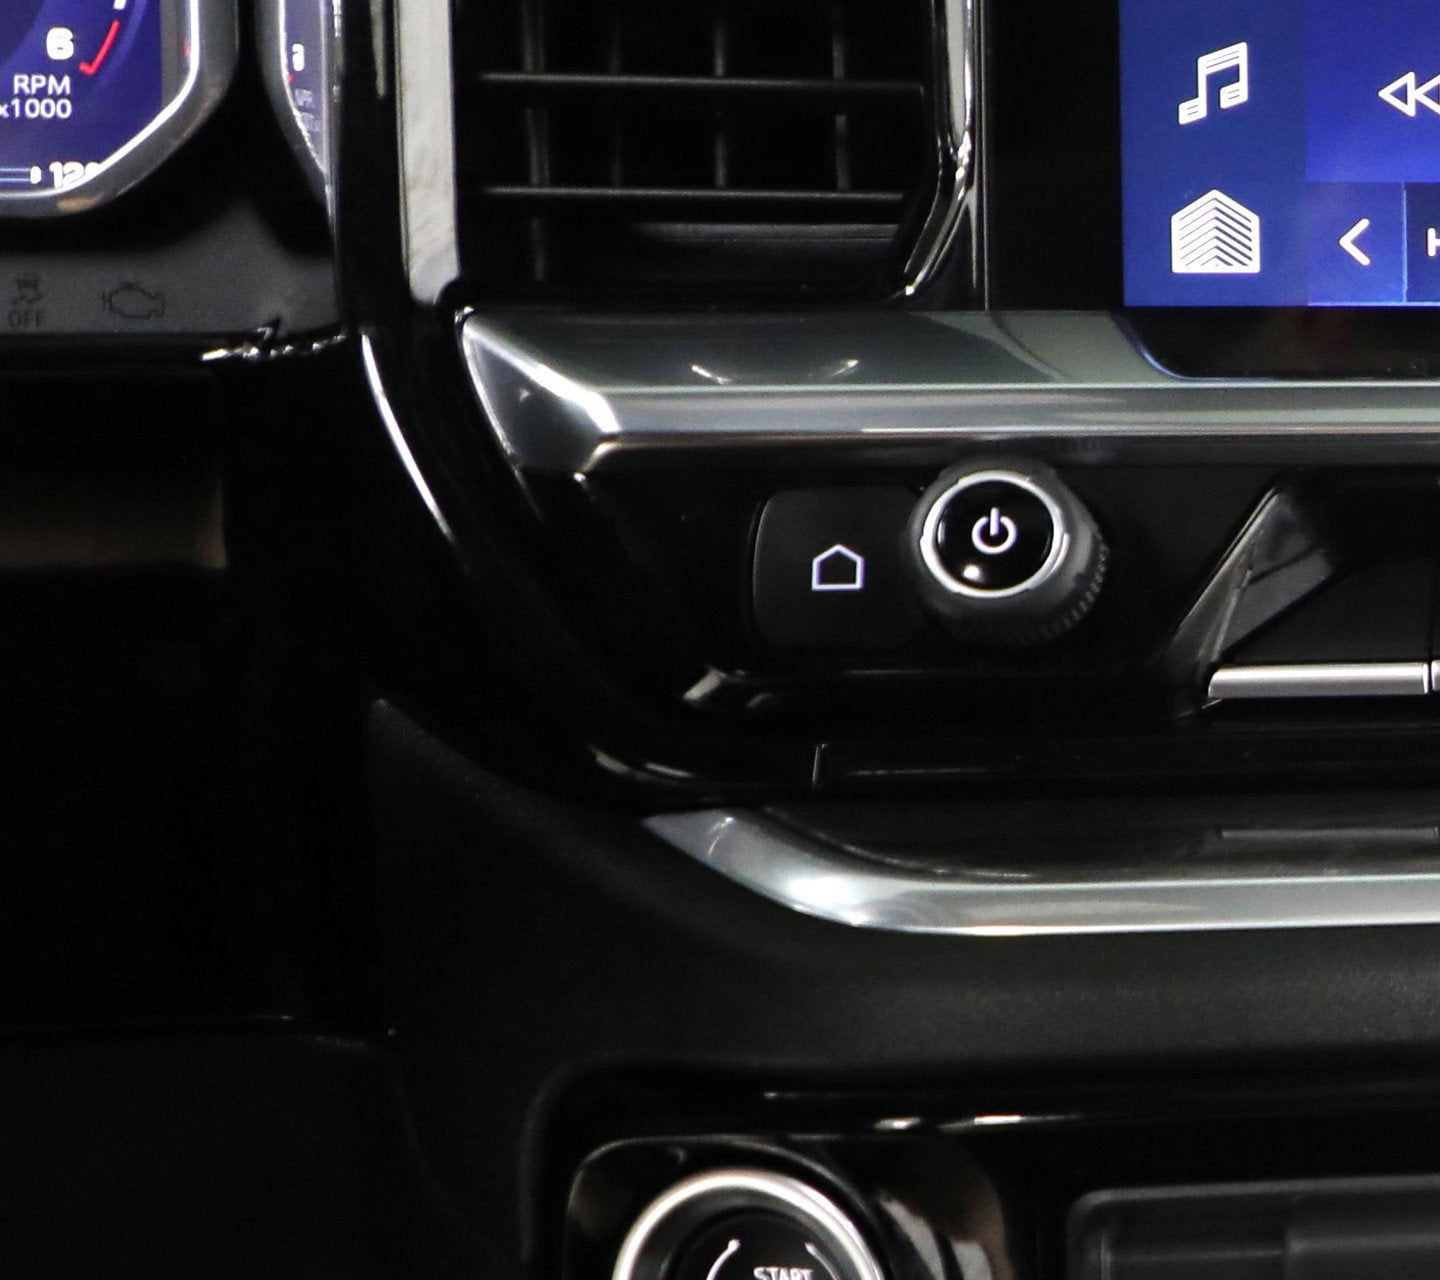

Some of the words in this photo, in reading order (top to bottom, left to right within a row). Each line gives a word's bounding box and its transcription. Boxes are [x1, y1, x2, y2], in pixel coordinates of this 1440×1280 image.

[45, 27, 75, 61] 6
[13, 74, 71, 96] RPM
[0, 98, 72, 119] x1000
